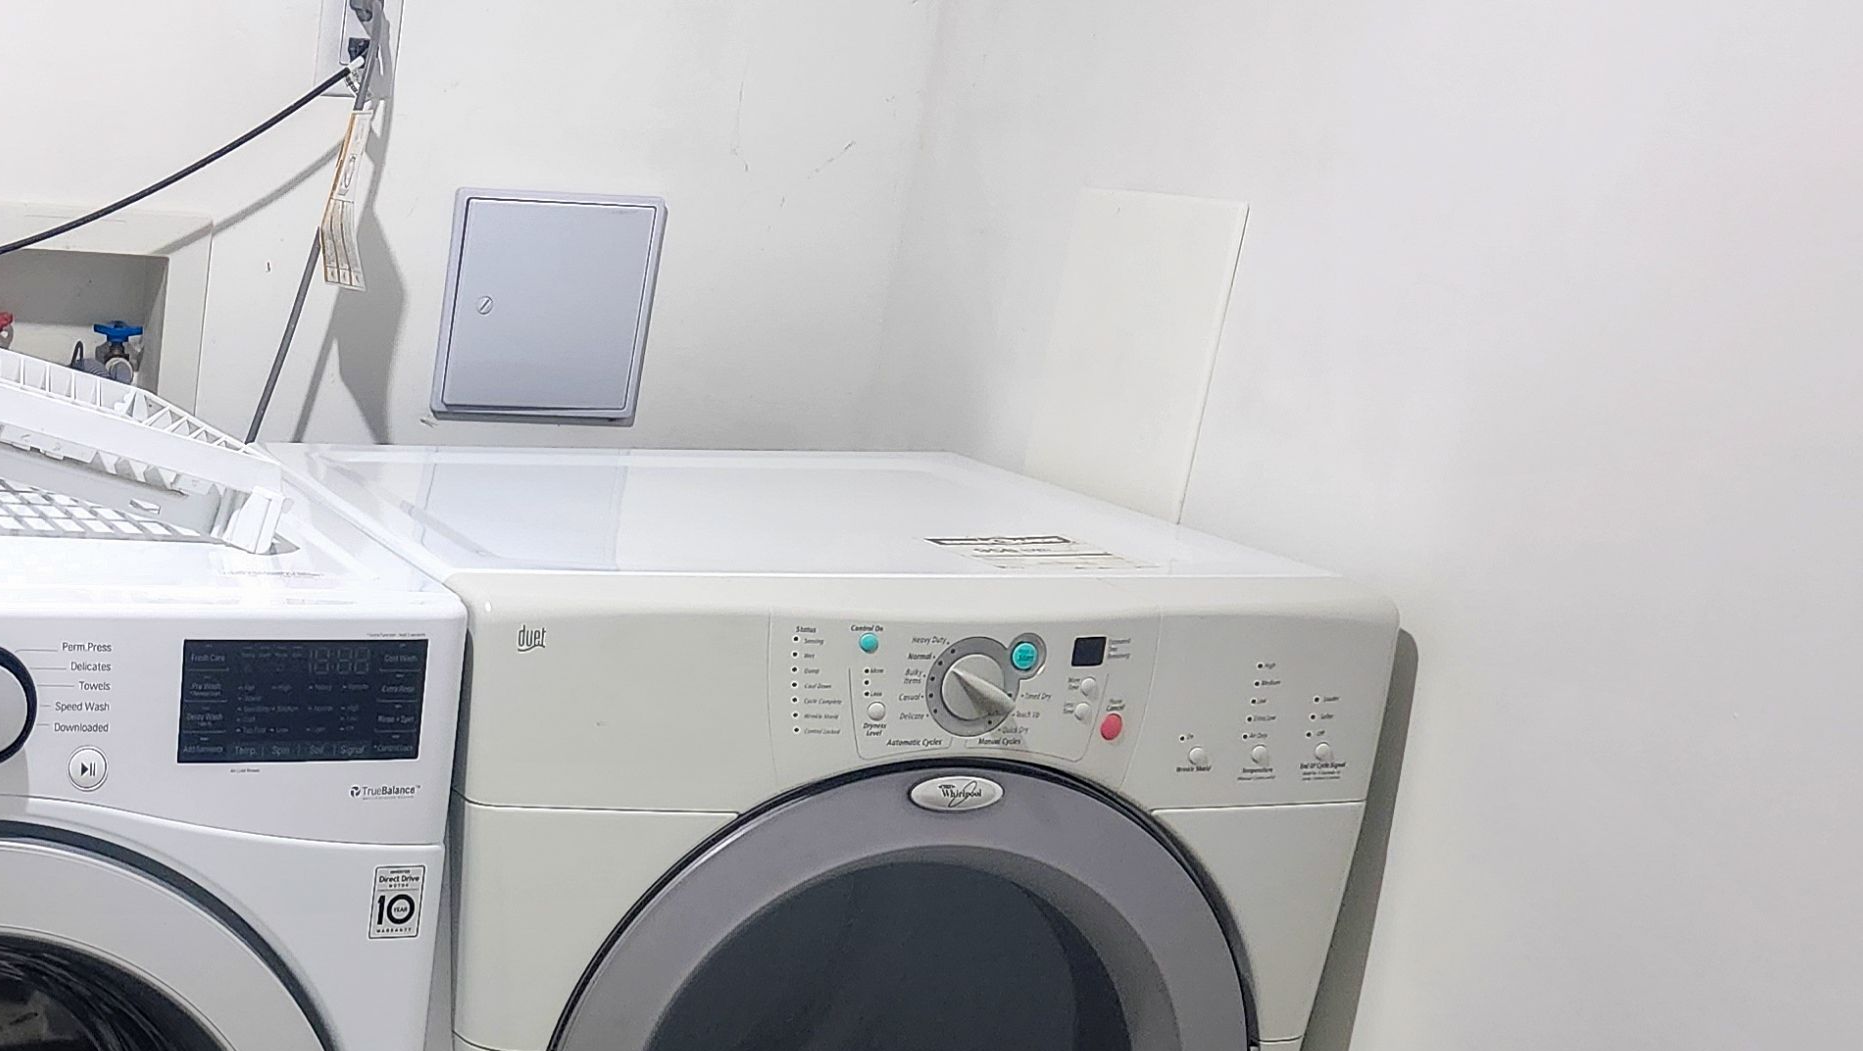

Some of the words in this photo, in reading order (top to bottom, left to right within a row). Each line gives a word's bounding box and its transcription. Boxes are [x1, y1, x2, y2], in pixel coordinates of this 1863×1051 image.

[517, 625, 546, 652] duet
[62, 642, 82, 652] Perm
[84, 642, 112, 652] Press
[70, 661, 111, 672] Delicates
[79, 681, 111, 691] Towels
[55, 702, 83, 713] Speed
[84, 702, 110, 712] Wash
[54, 722, 109, 733] Downloaded
[886, 738, 921, 746] Automatic
[922, 738, 942, 747] Cycles
[1002, 738, 1022, 746] Cycles
[941, 788, 982, 799] Whirlpool
[379, 875, 400, 883] Direct
[377, 894, 415, 925] 10
